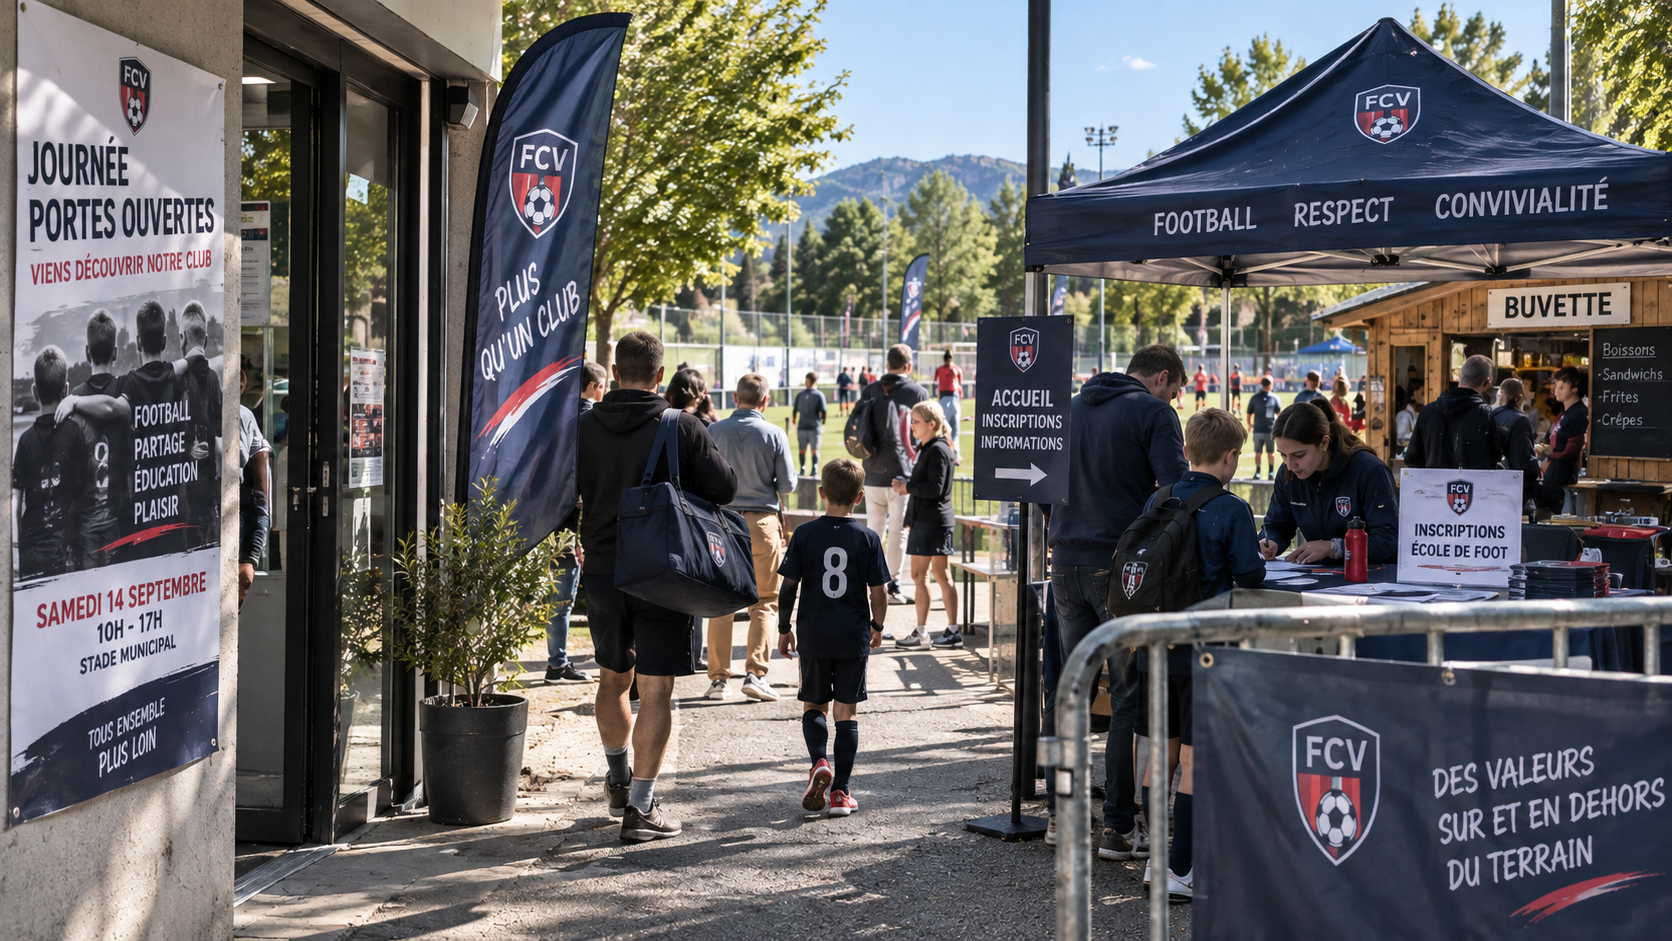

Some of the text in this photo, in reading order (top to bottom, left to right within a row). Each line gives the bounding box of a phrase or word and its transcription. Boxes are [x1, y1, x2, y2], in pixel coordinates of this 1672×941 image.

[124, 65, 148, 88] FCV
[1365, 91, 1412, 110] FCV
[28, 136, 128, 186] JOURNÉE
[520, 144, 568, 171] FCV
[29, 198, 214, 242] PORTES OUVERTES
[1153, 176, 1609, 236] FOOTBALL RESPECT CONVIVIALITÉ
[31, 250, 212, 285] VIENS DÉCOUVRIR NOTRE CLUB
[494, 262, 540, 322] PLUS
[1505, 292, 1612, 319] BUVETTE
[480, 280, 580, 381] QU'UN CLUB
[1014, 334, 1035, 345] FCV
[1603, 342, 1656, 356] Boissons
[134, 400, 191, 429] FOOTBALL
[992, 389, 1053, 407] ACCUEIL
[982, 413, 1062, 429] INSCRIPTIONS
[134, 432, 185, 460] PARTAGE
[981, 435, 1063, 451] INFORMATIONS
[134, 460, 198, 493] ÉDUCATION
[1450, 484, 1470, 494] FCV
[134, 495, 178, 524] PLAISIR
[1414, 523, 1505, 539] INSCRIPTIONS
[1411, 540, 1508, 559] ÉCOLE DE FOOT
[822, 546, 848, 599] 8
[36, 571, 206, 629] SAMEDI 14 SEPTEMBRE
[97, 619, 124, 644] 10H
[139, 609, 162, 633] 17H
[80, 634, 176, 674] STADE MUNICIPAL
[88, 697, 165, 750] TOUS ENSEMBLE
[98, 726, 157, 777] PLUS LOIN
[1306, 735, 1368, 772] FCV
[1432, 745, 1595, 798] DES VALEURS
[1438, 777, 1666, 845] SUR ET EN DEHORS
[1447, 835, 1594, 891] DU TERRAIN
